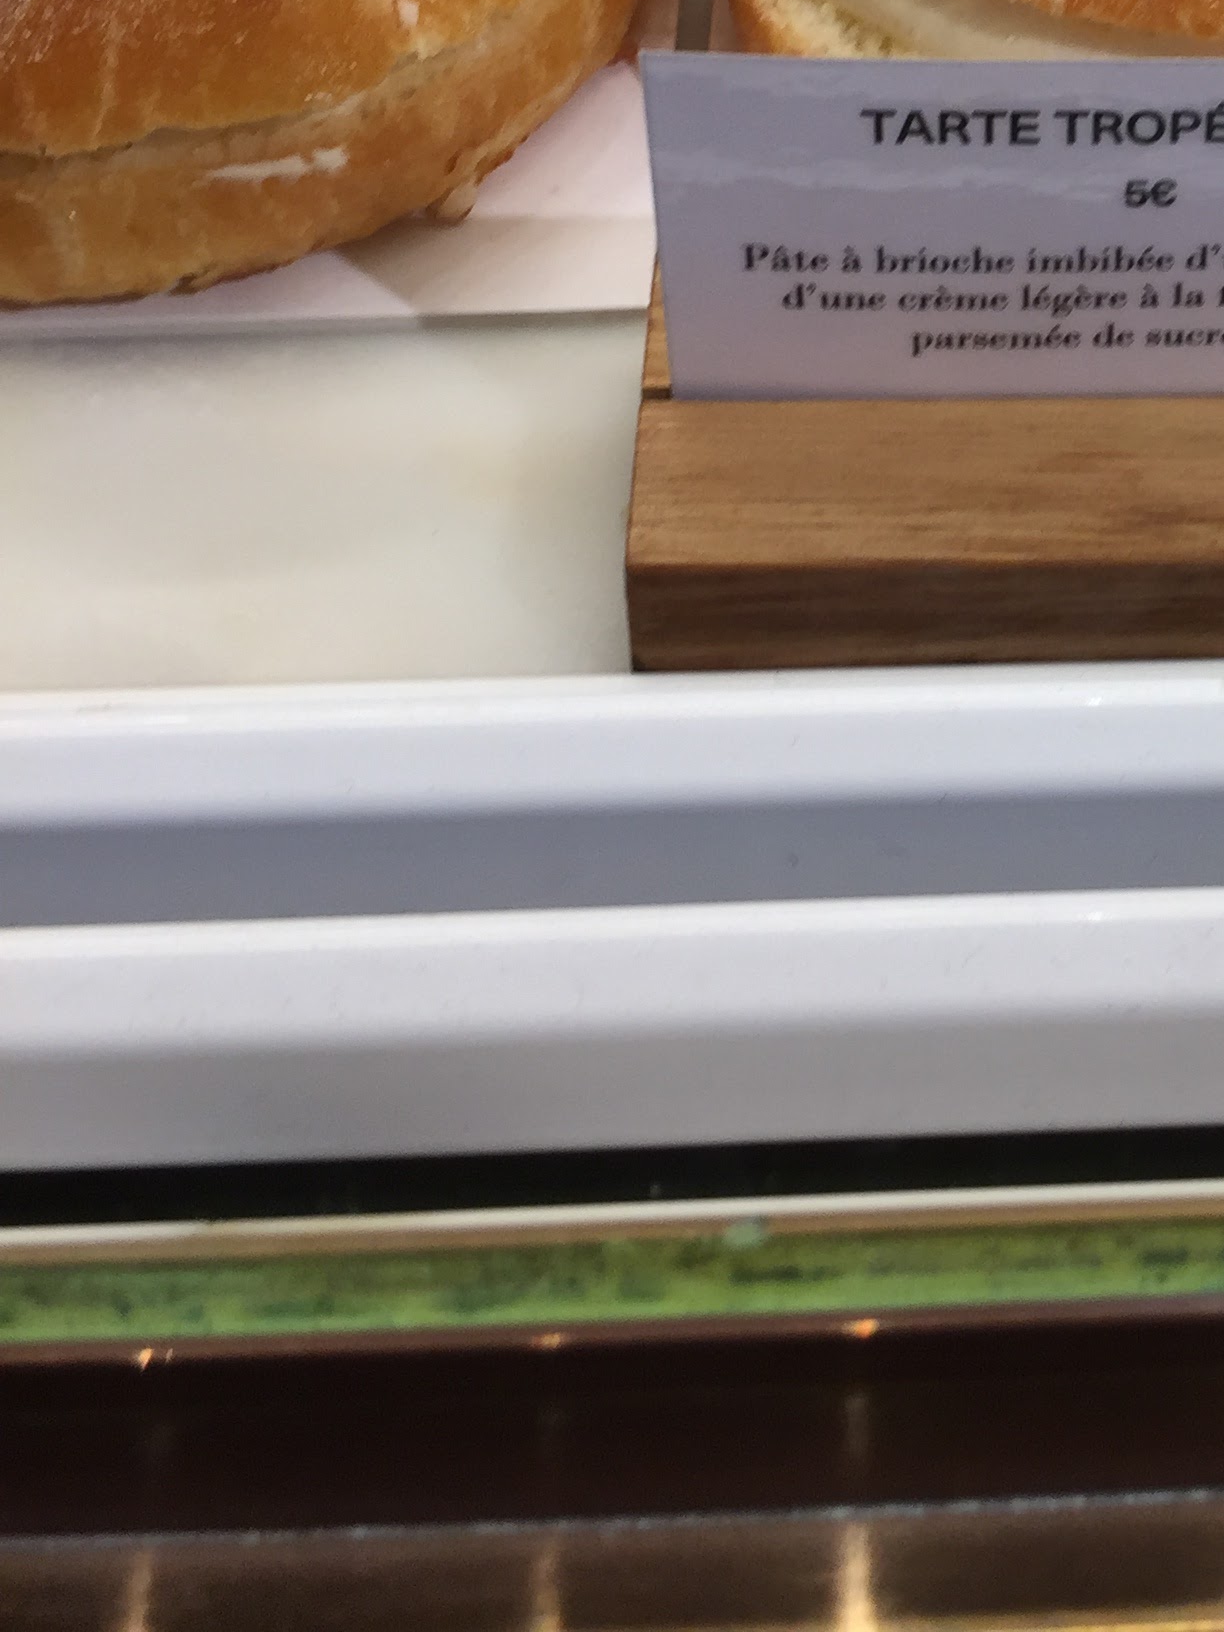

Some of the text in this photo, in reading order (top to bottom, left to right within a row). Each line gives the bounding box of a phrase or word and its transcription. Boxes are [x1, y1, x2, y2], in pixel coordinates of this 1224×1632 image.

[860, 106, 1041, 147] TARTE
[1123, 178, 1176, 210] 5€
[744, 243, 829, 273] Pâte
[842, 244, 862, 273] à
[875, 244, 1012, 275] brioche
[1026, 244, 1175, 273] imbibée
[782, 281, 885, 311] d'une
[897, 283, 1008, 311] crème
[1021, 281, 1127, 318] légère
[1139, 281, 1160, 310] à
[1171, 281, 1204, 310] la
[911, 323, 1080, 358] parsemée
[1092, 321, 1133, 349] de
